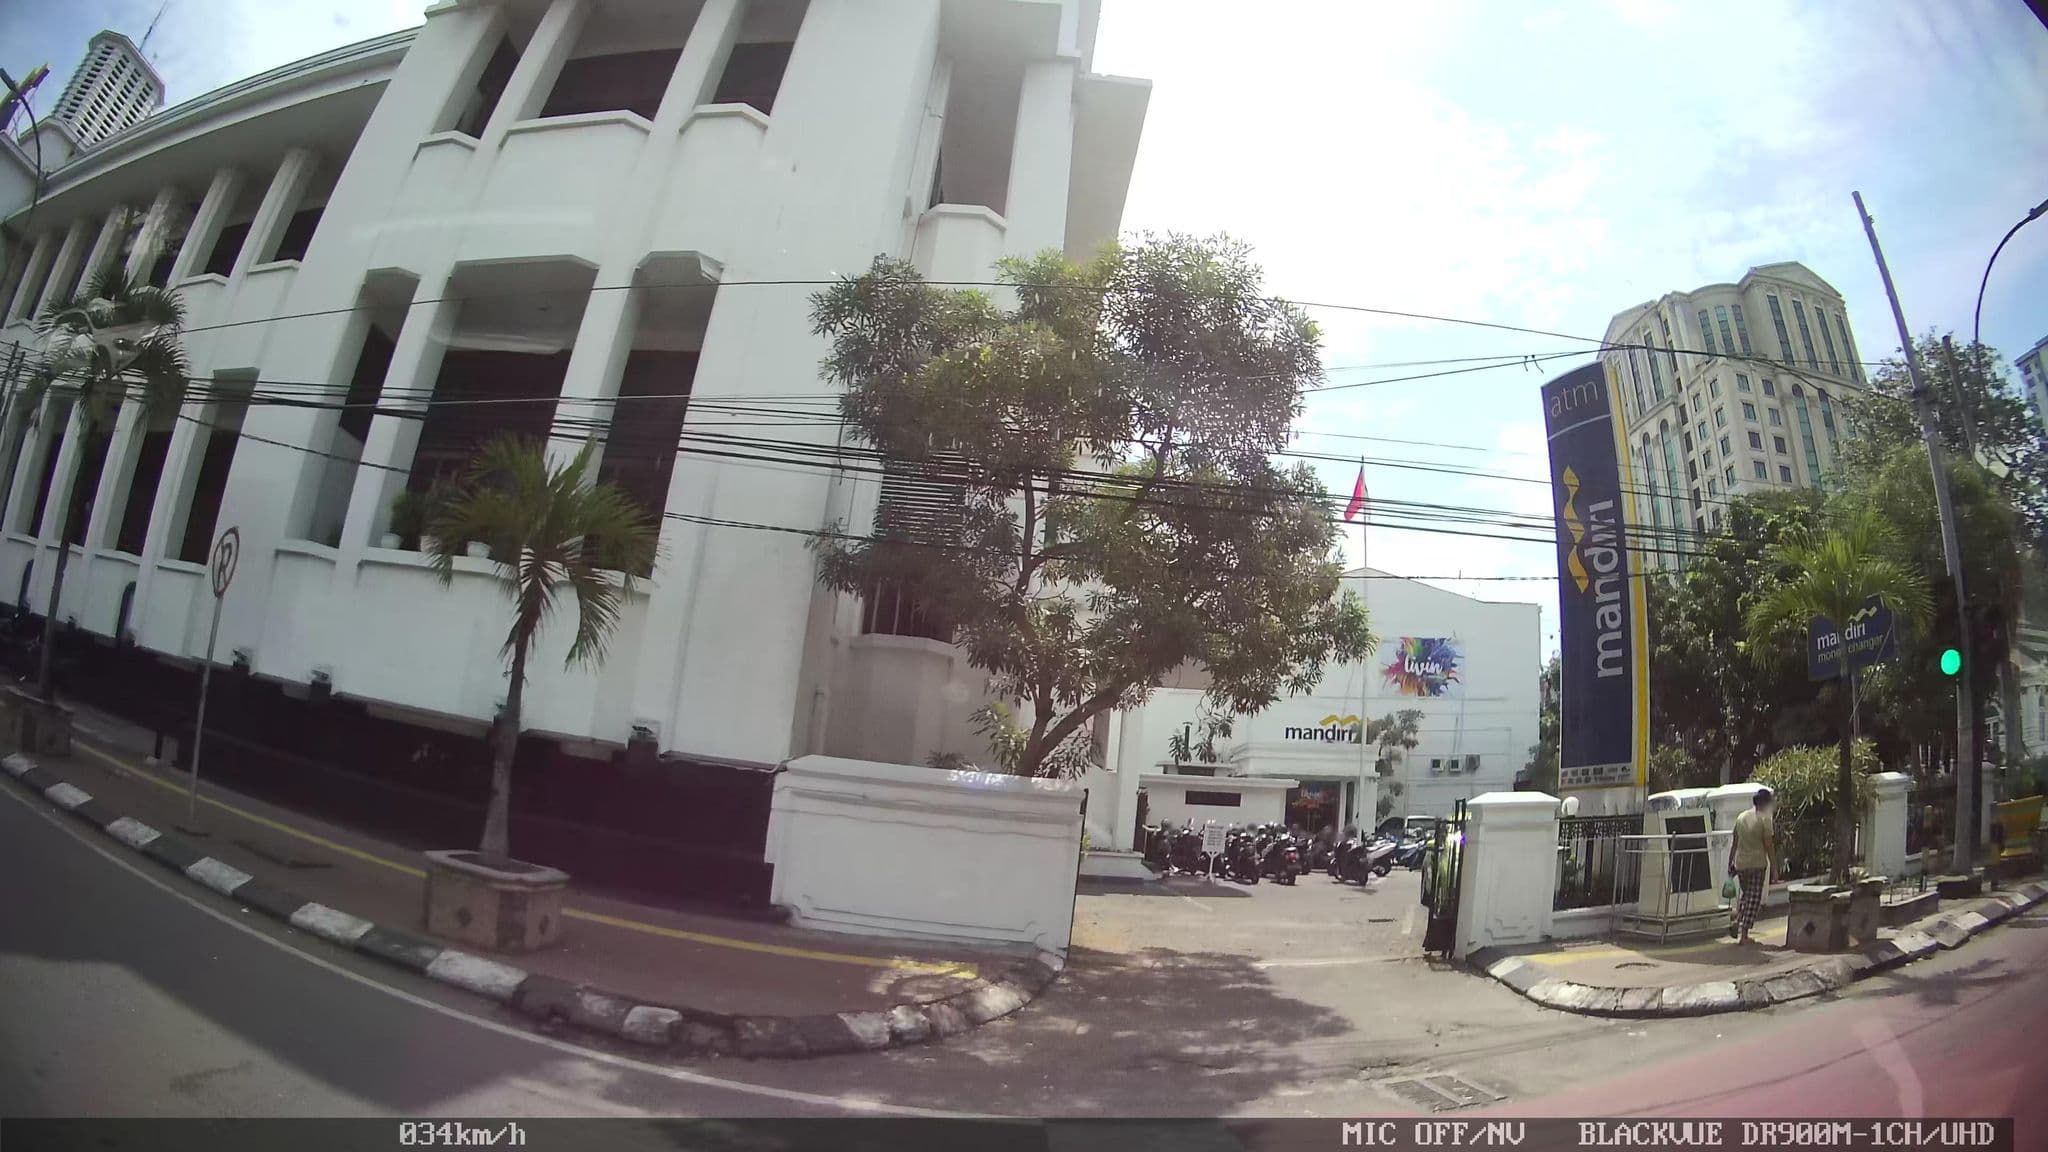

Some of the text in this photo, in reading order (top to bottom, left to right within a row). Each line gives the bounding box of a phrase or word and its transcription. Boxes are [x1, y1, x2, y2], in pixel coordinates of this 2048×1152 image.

[1551, 381, 1599, 417] atm
[1584, 499, 1624, 678] mandiri
[1404, 655, 1442, 676] livin
[1285, 724, 1354, 741] mandiri
